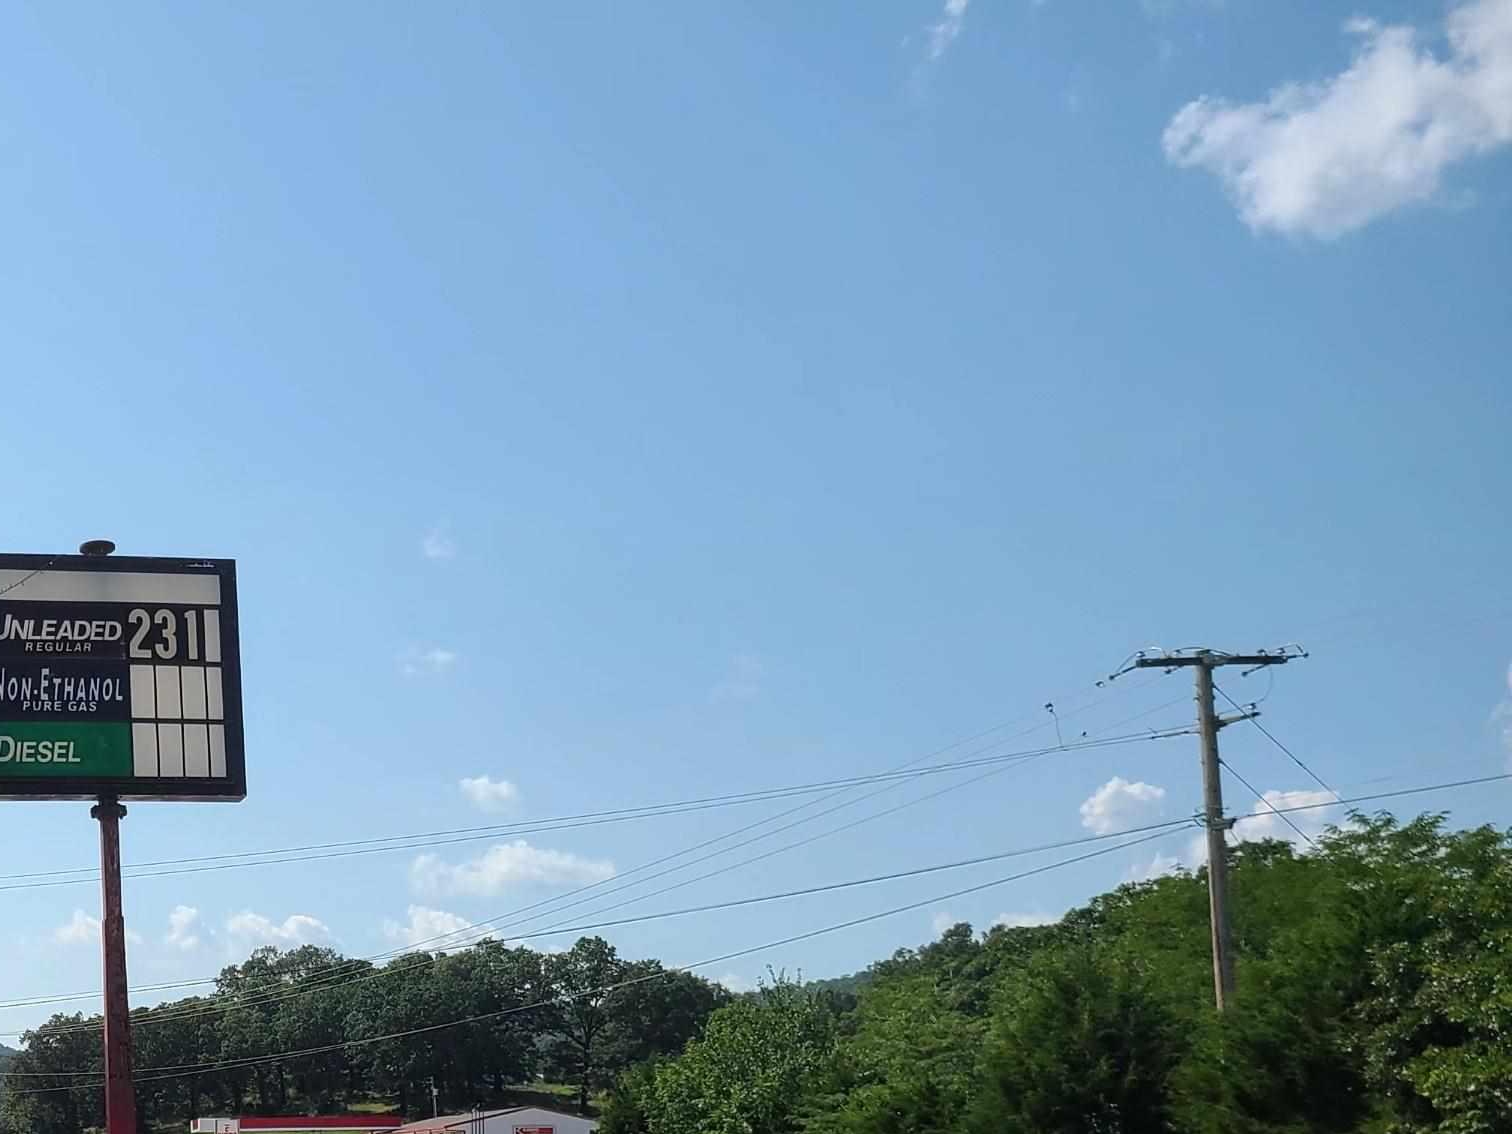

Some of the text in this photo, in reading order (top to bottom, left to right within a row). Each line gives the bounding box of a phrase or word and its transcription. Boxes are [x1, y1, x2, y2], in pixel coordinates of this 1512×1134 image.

[127, 608, 199, 660] 231
[24, 642, 93, 653] REGULAR
[22, 700, 98, 713] PURE GAS
